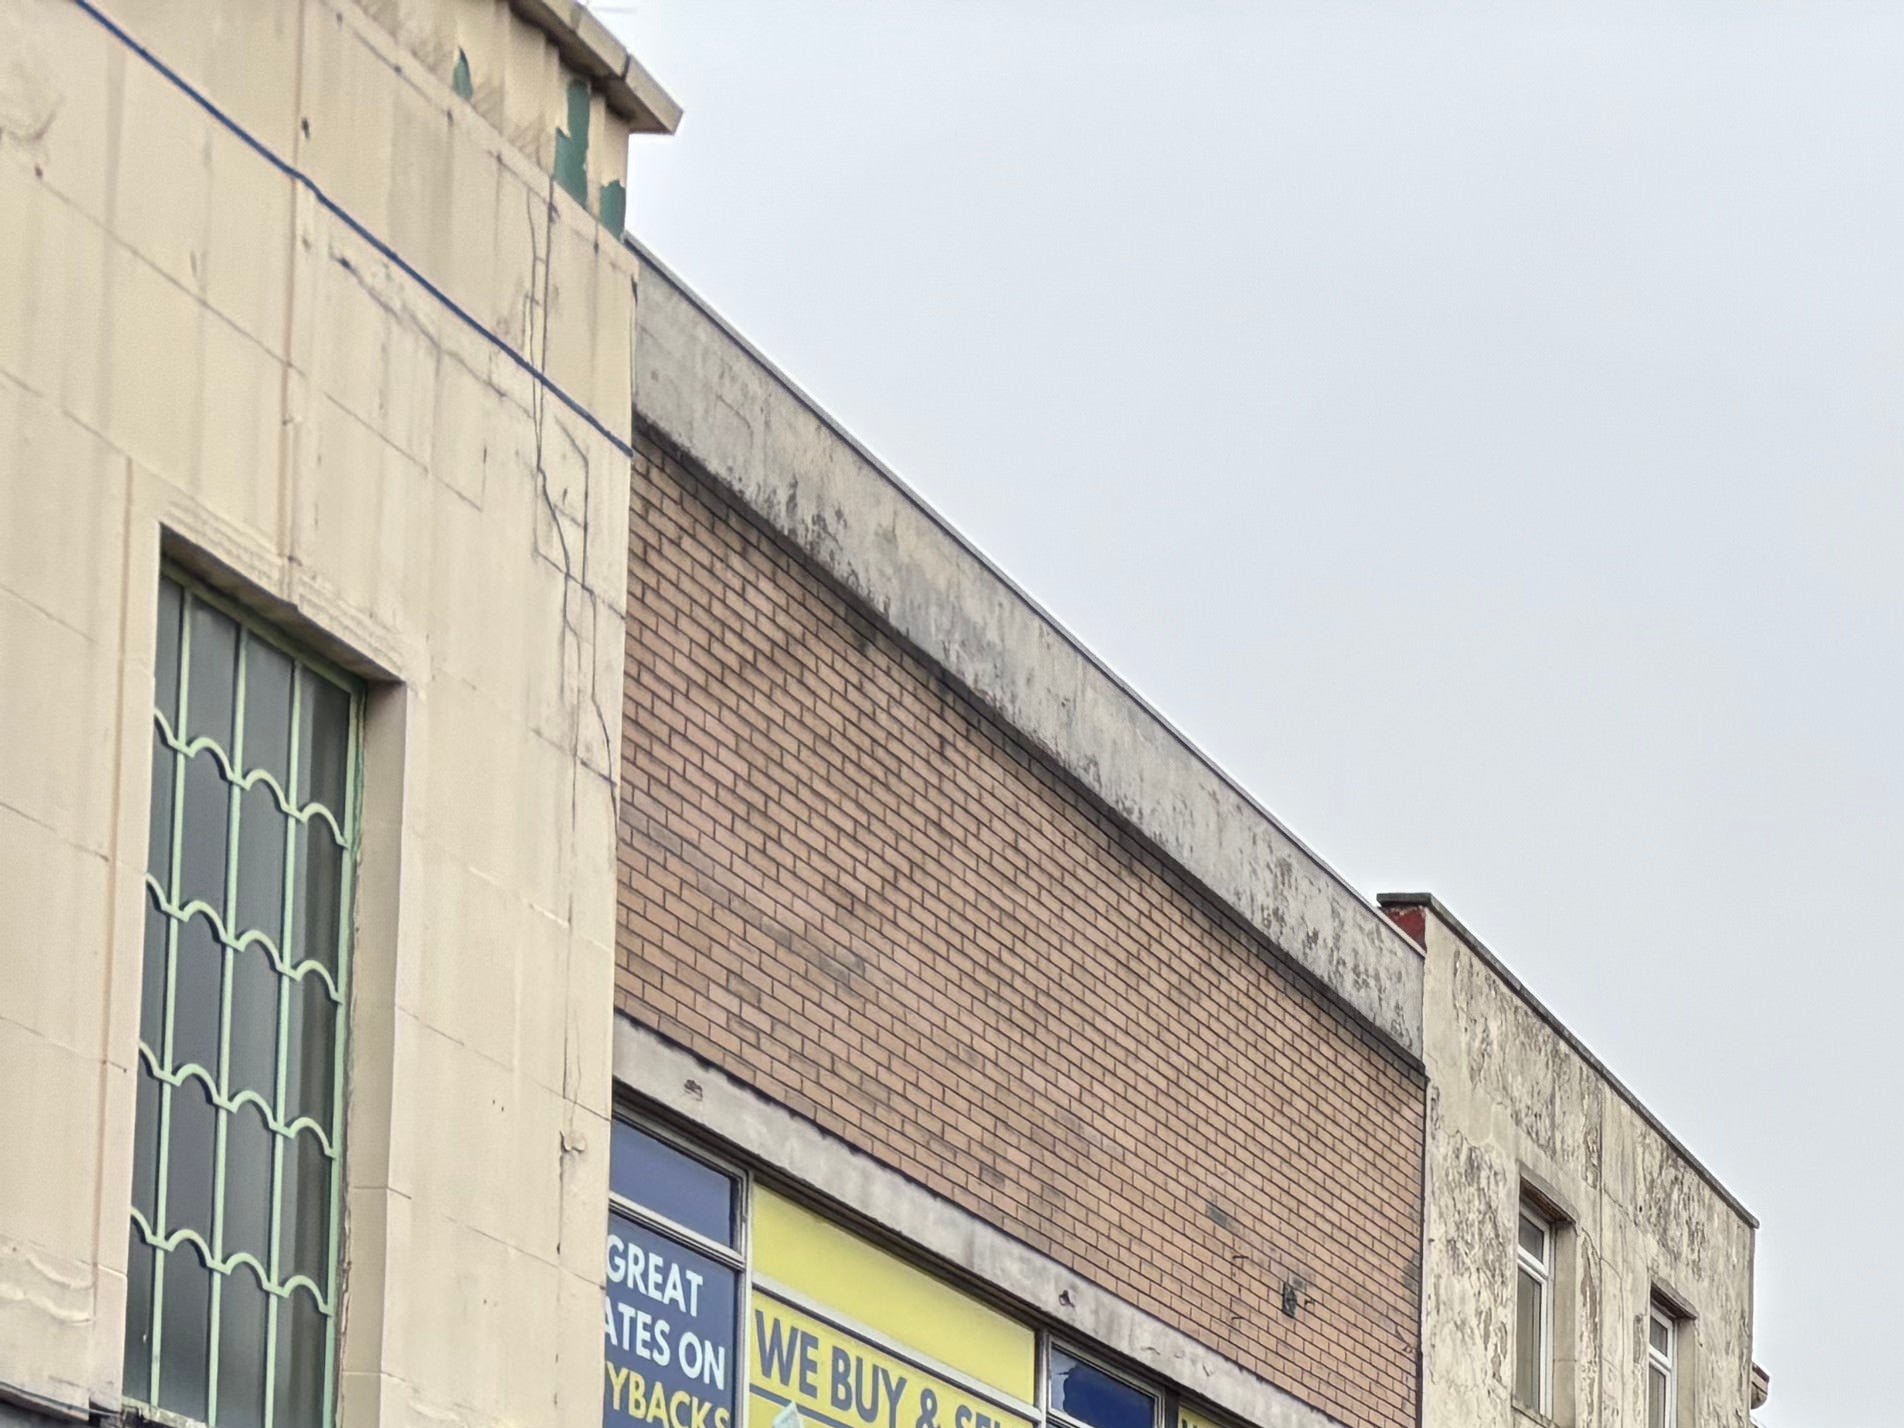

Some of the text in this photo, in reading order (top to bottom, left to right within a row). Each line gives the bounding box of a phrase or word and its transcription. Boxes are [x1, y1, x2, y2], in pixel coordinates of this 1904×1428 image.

[607, 1235, 703, 1317] GREAT
[679, 1331, 725, 1390] ON
[754, 1308, 819, 1398] WE
